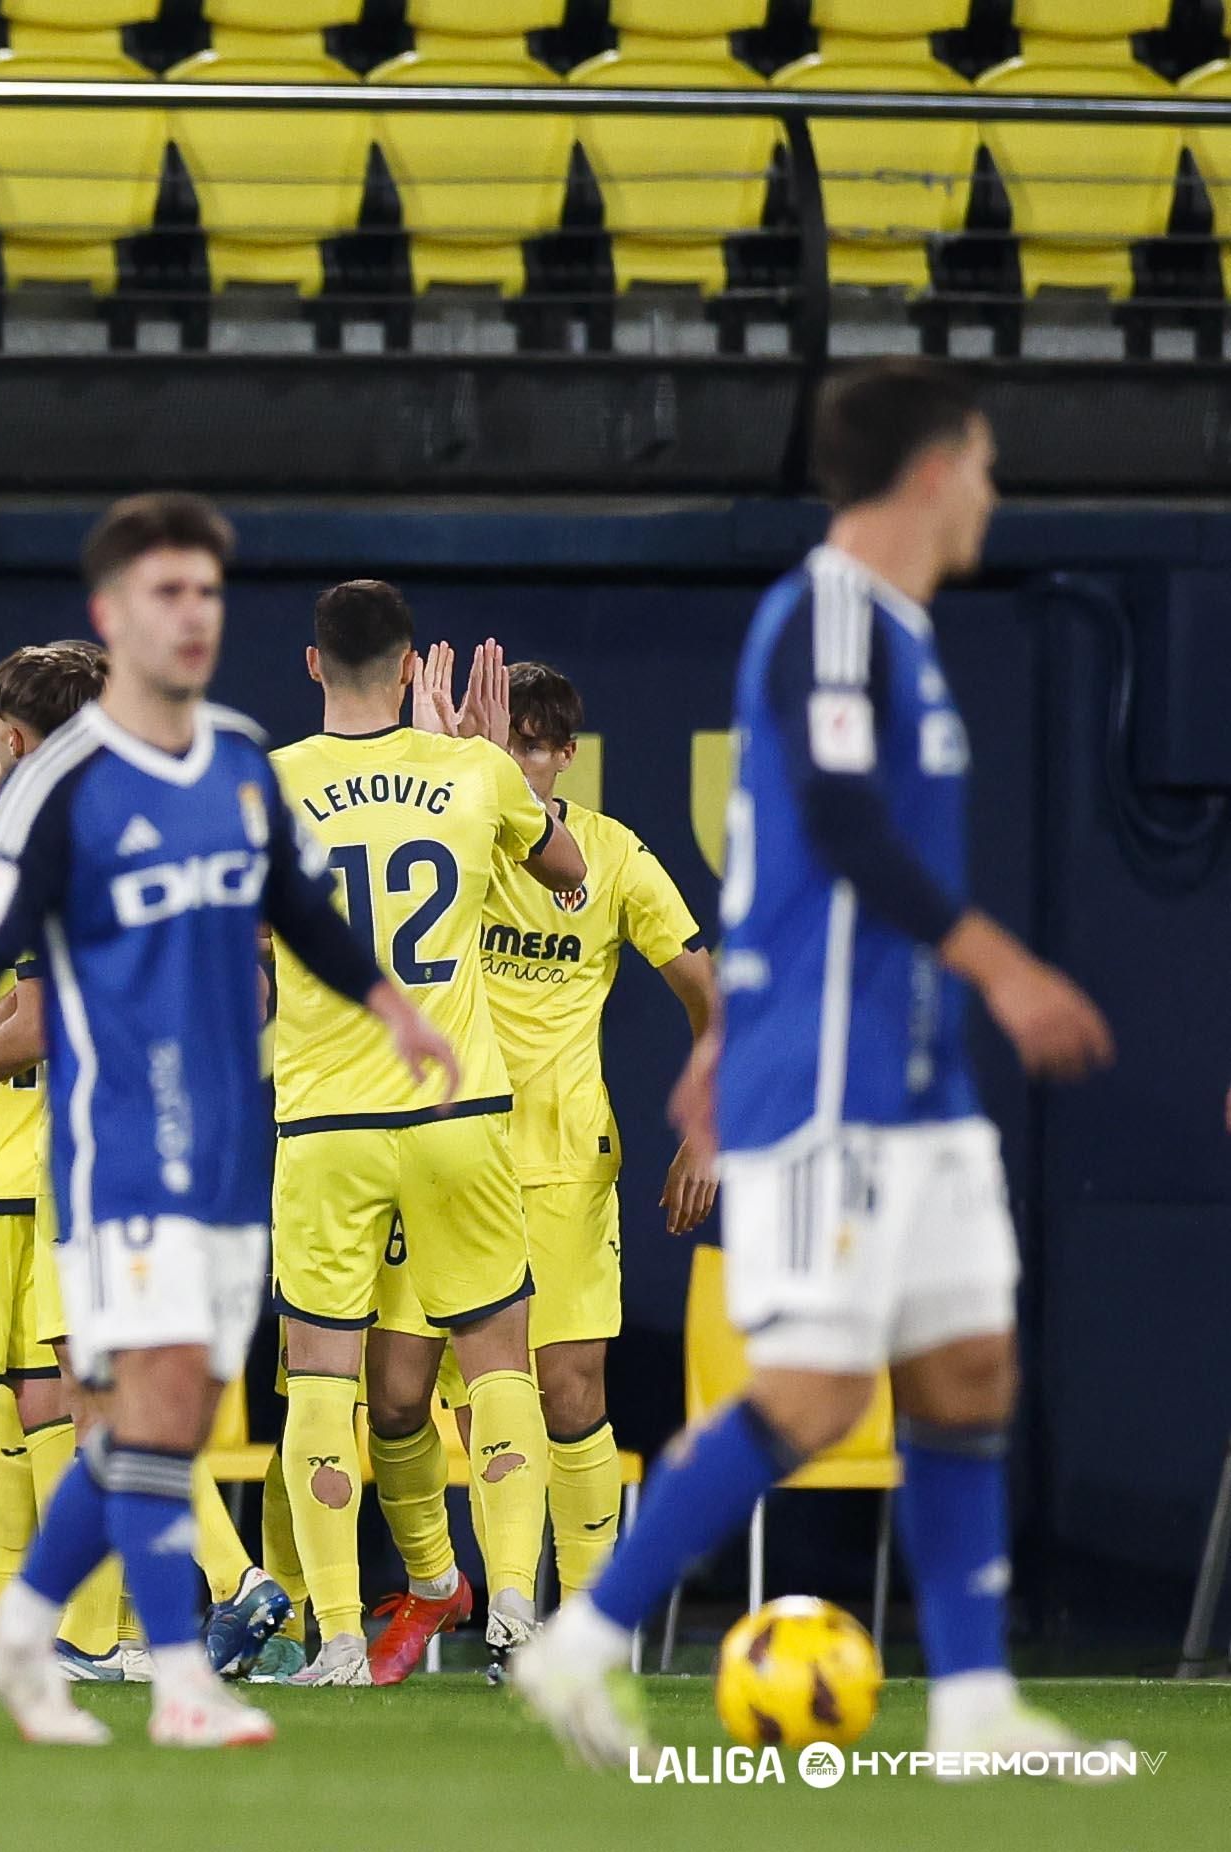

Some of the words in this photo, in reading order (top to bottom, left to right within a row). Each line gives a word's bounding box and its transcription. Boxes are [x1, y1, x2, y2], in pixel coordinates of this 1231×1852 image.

[302, 773, 455, 823] LEKOVIĆ
[327, 839, 459, 985] 12
[480, 922, 582, 963] MESA
